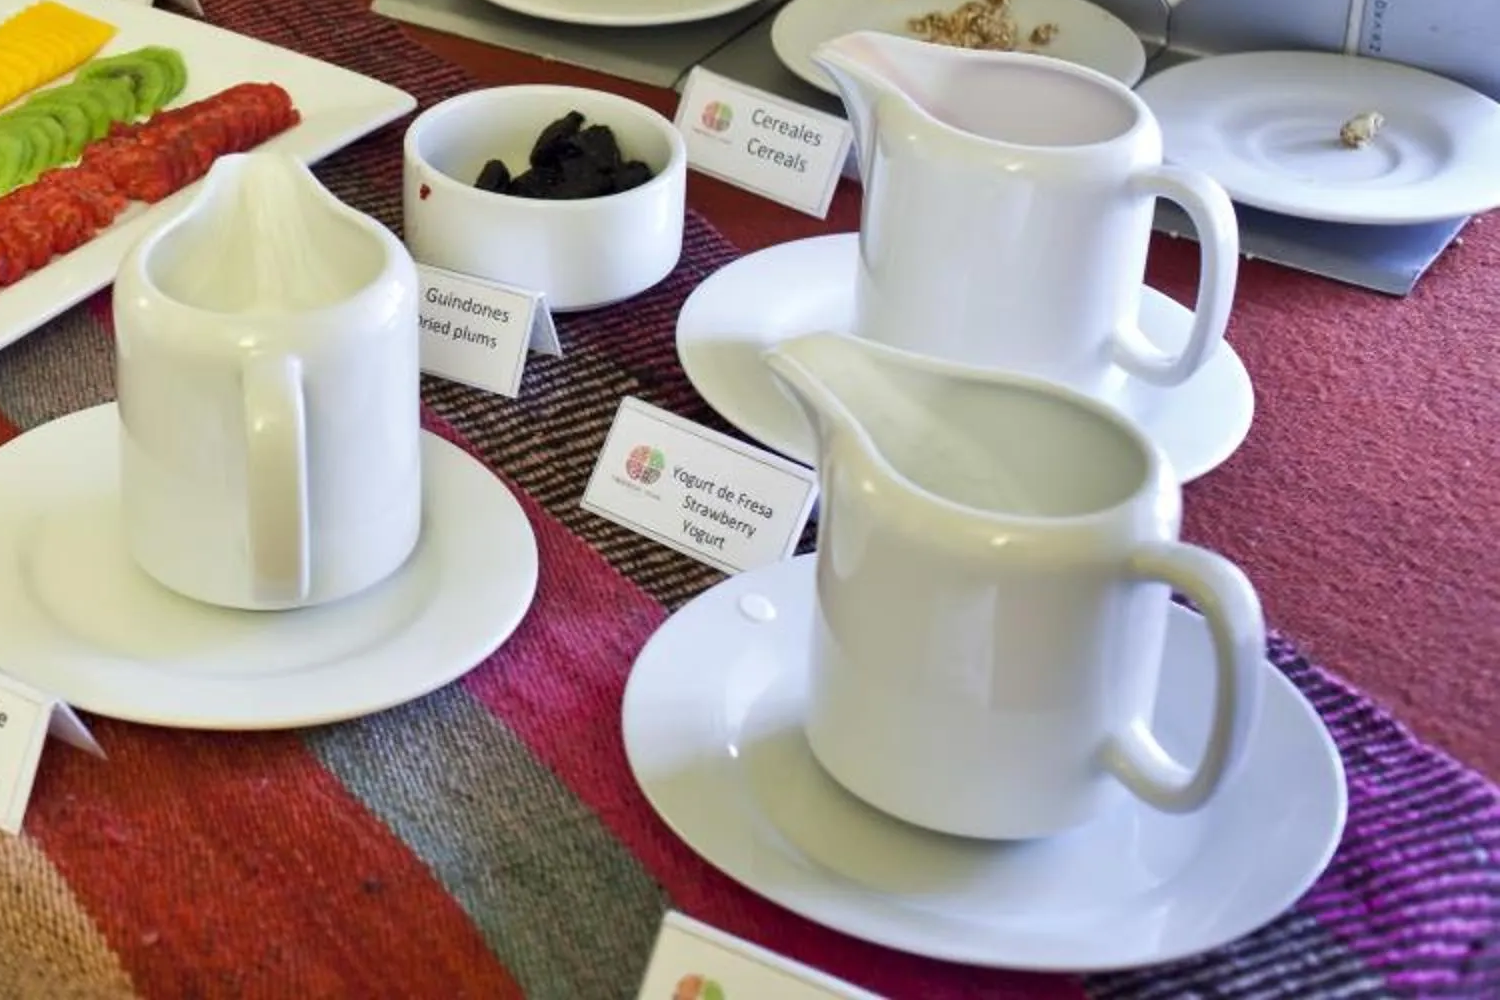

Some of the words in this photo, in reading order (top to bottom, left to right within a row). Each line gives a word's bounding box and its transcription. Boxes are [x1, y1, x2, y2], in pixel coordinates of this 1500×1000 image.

[751, 108, 823, 147] Cereales
[747, 137, 809, 173] Cereals
[425, 286, 510, 323] Guindones
[451, 325, 498, 349] plums
[671, 464, 716, 495] Yogurt
[717, 484, 735, 504] de
[736, 493, 774, 519] Fresa
[681, 495, 757, 539] Strawberry
[682, 519, 726, 550] Yogurt
